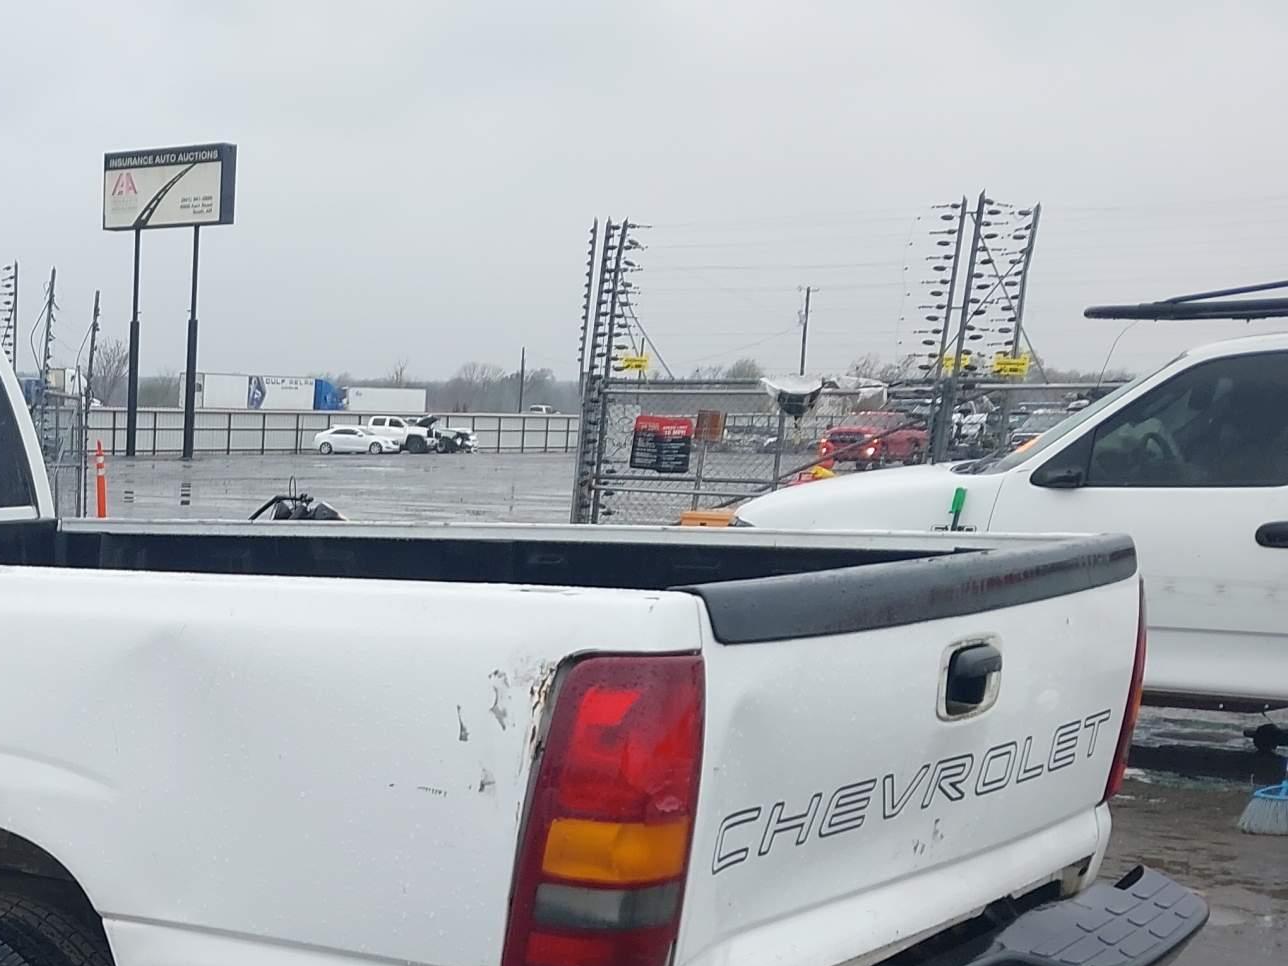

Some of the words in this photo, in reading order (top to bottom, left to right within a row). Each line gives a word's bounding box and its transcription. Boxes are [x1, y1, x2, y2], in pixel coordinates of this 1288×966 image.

[109, 155, 153, 168] INSURANCE
[154, 153, 177, 163] AUTO
[178, 150, 218, 162] AUCTIONS
[711, 708, 1112, 875] CHEVROLET
